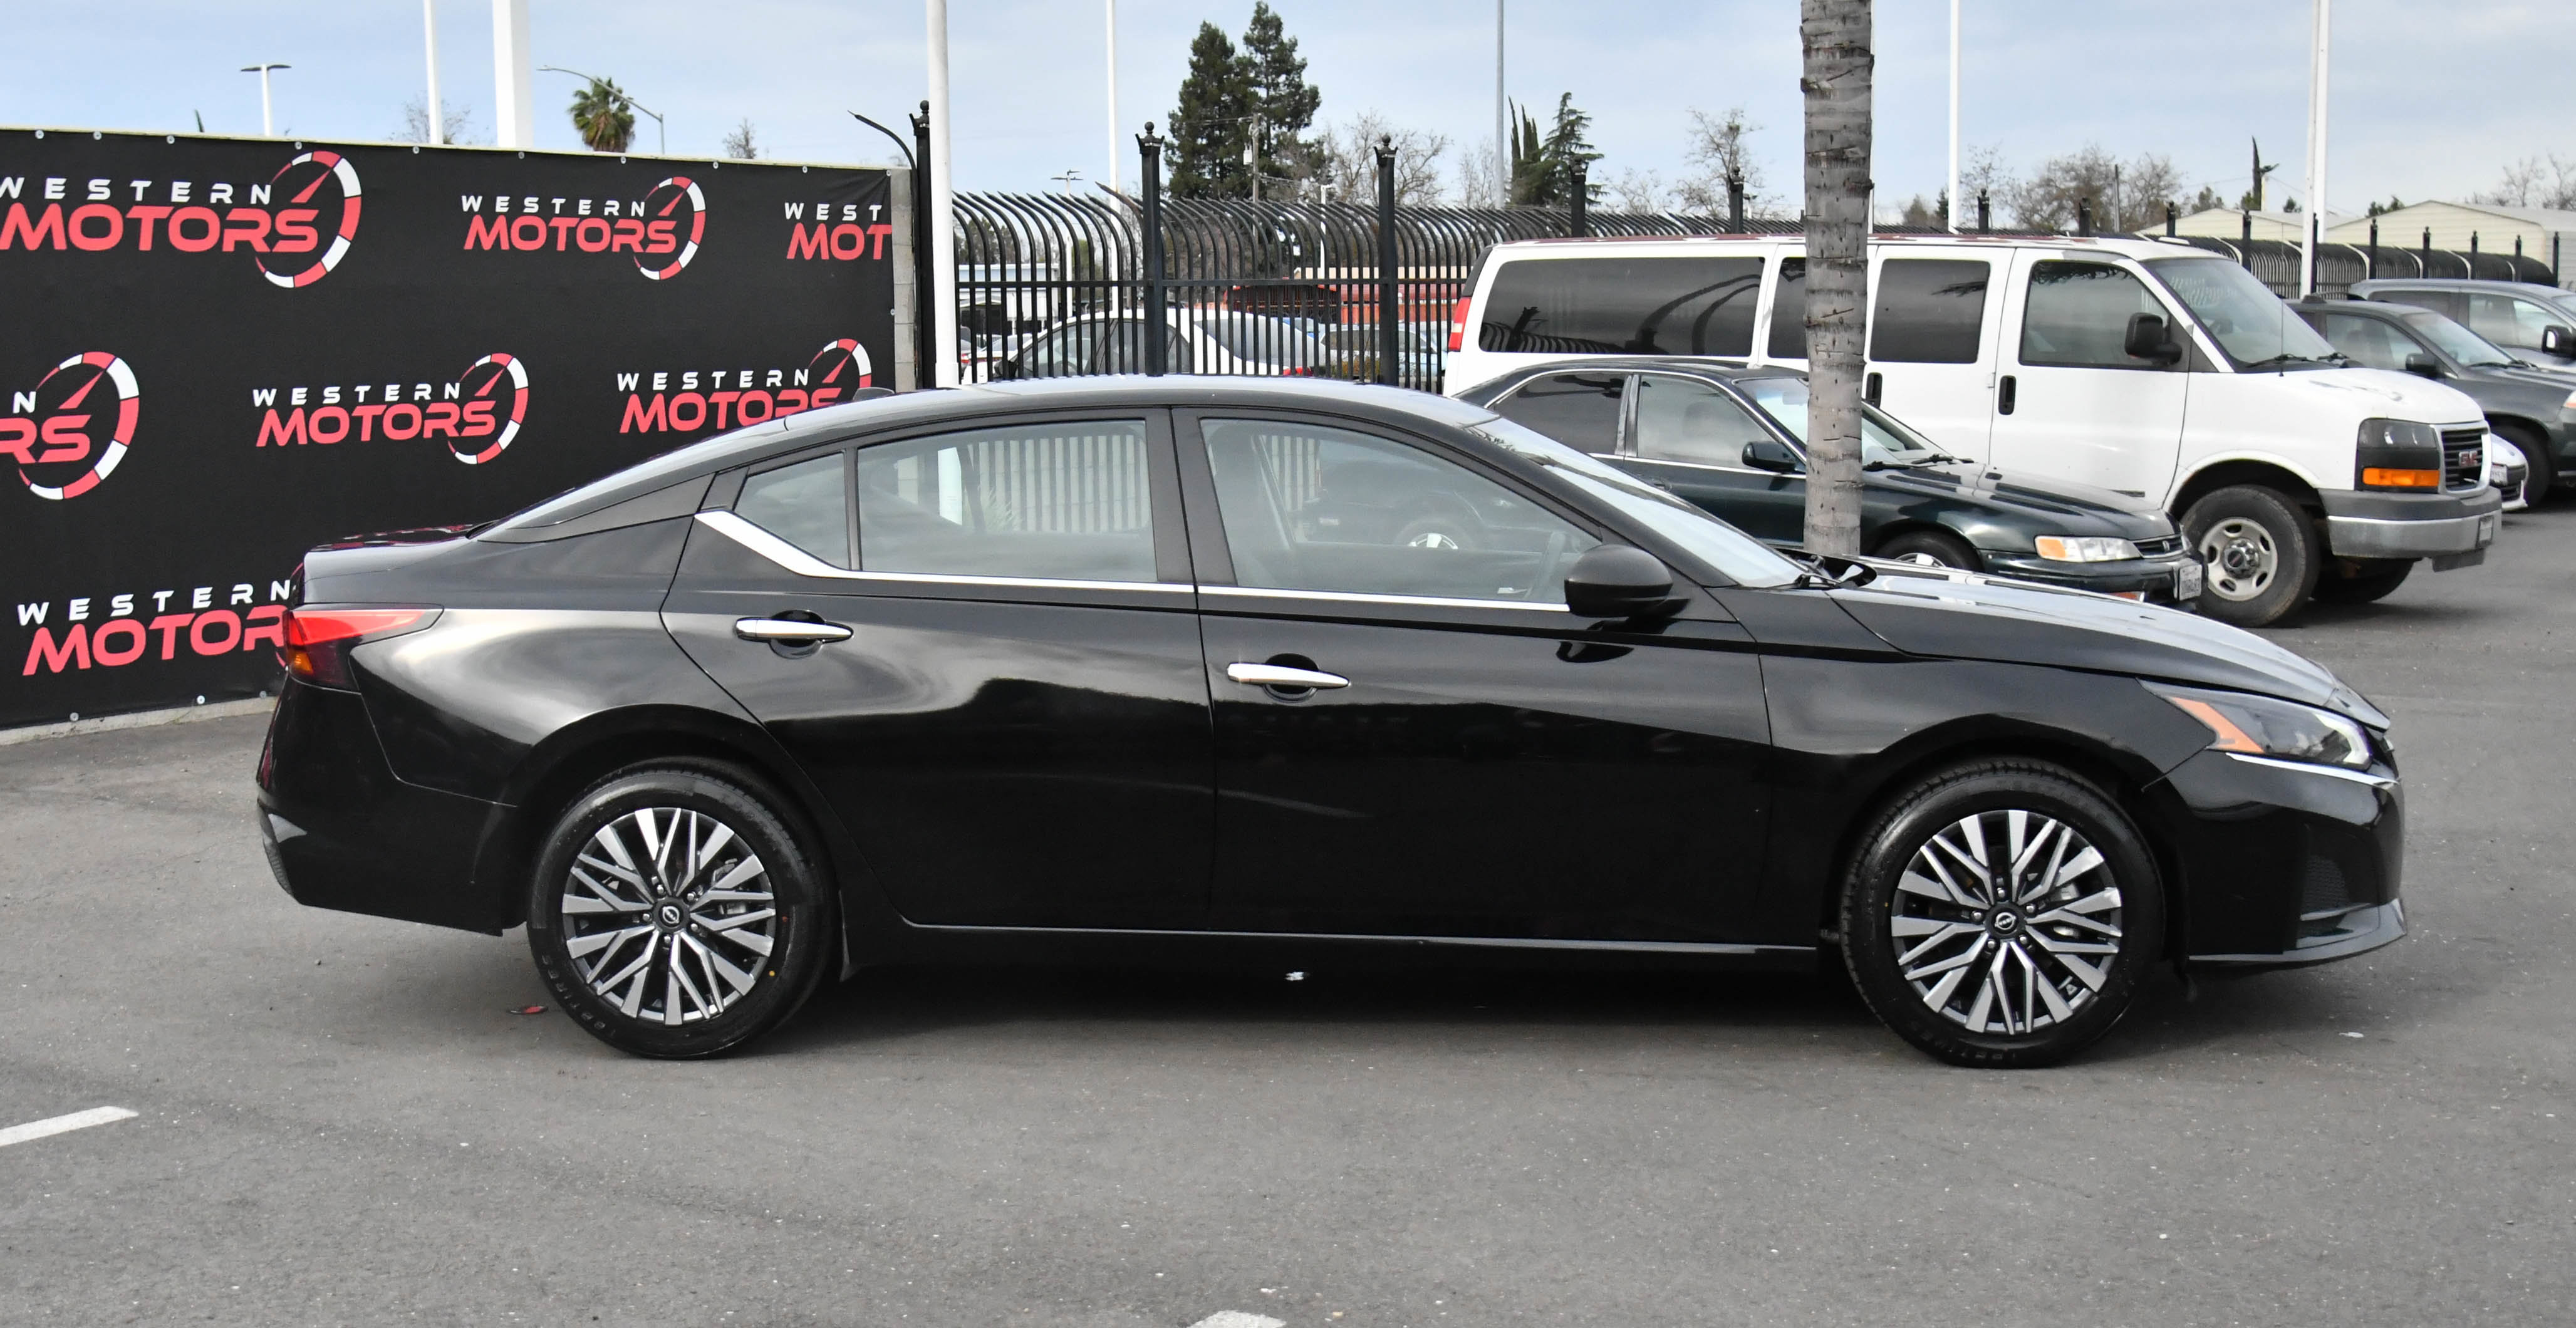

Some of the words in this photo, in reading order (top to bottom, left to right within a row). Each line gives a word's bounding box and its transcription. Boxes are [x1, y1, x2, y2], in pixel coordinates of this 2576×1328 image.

[0, 177, 271, 204] WESTERN
[462, 195, 645, 217] WESTERN
[0, 202, 318, 252] MOTORS
[784, 202, 882, 221] WEST
[464, 215, 677, 254] MOTORS
[786, 222, 893, 261] MOT
[252, 383, 460, 407] WESTERN
[618, 369, 809, 392] WESTERN
[256, 401, 496, 447] MOTORS
[18, 579, 291, 626] WESTERN
